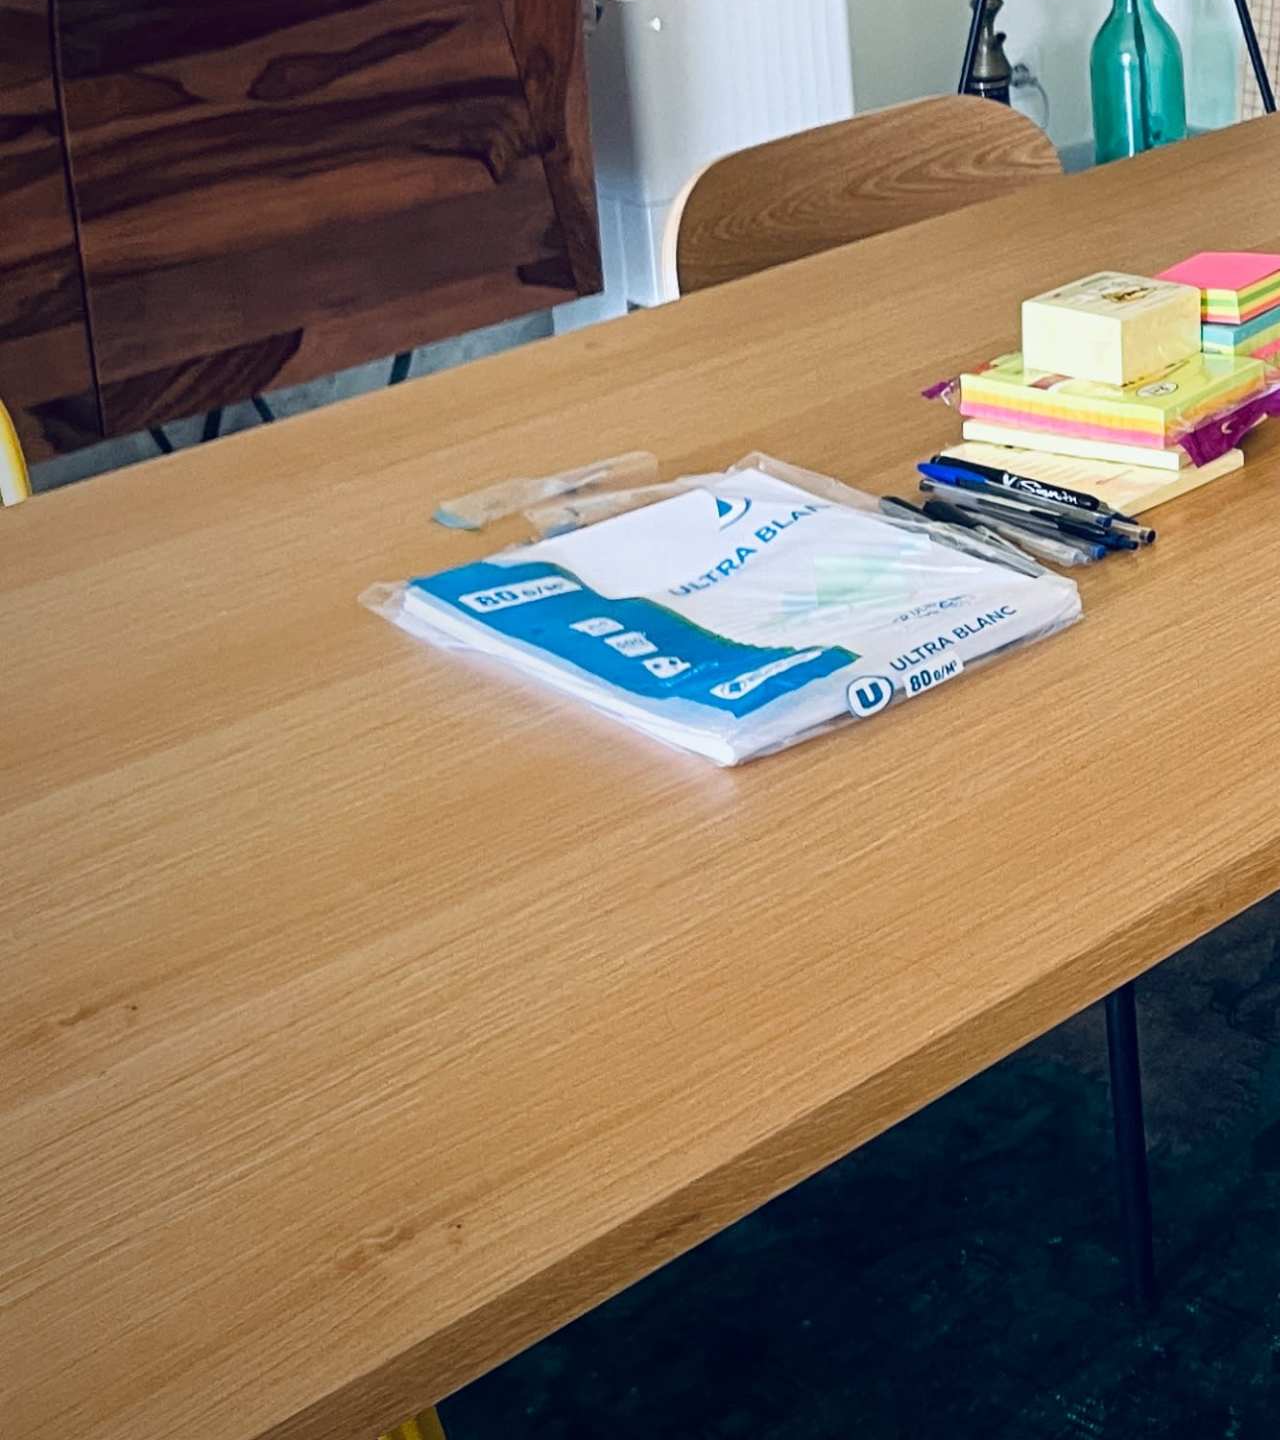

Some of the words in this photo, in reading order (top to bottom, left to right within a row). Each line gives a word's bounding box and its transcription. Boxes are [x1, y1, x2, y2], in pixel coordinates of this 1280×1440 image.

[668, 546, 757, 596] ULTRA
[889, 636, 954, 672] ULTRA
[951, 605, 1017, 641] BLANC
[855, 681, 884, 710] U
[910, 669, 932, 692] 80
